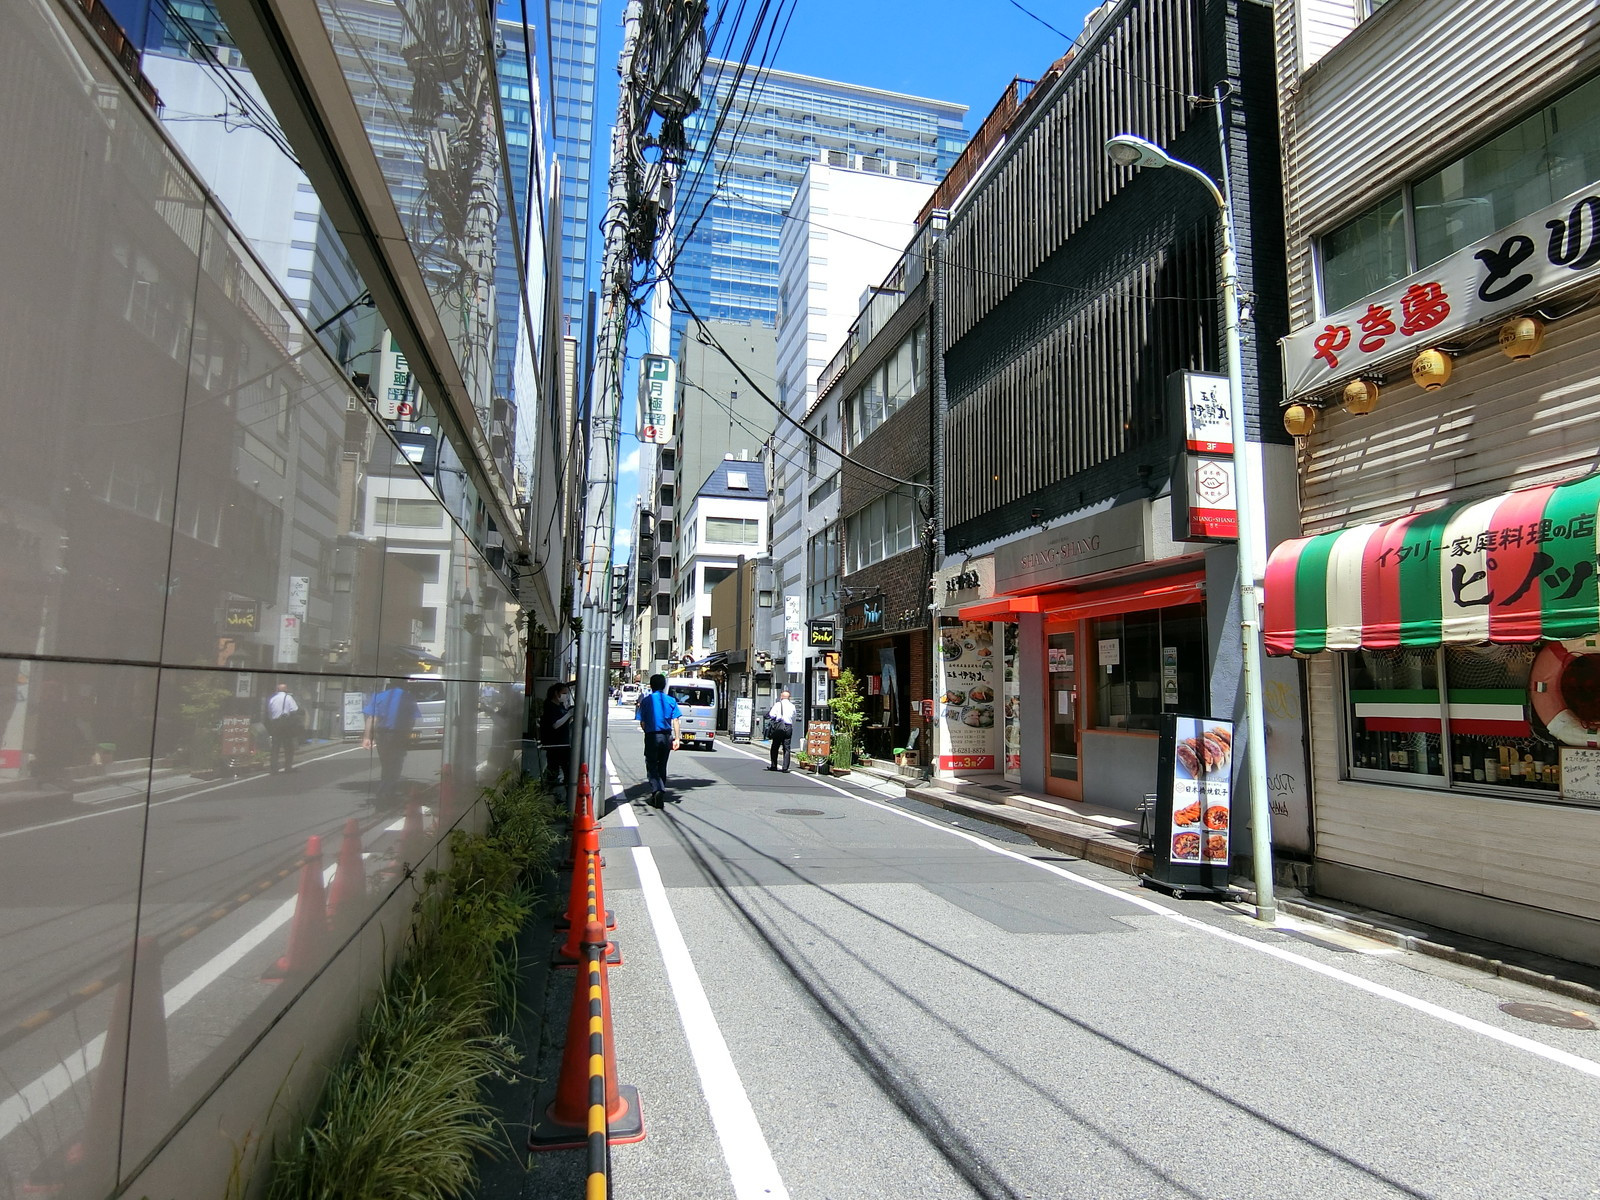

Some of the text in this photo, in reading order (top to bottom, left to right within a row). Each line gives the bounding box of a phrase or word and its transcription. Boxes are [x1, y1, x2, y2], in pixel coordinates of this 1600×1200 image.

[1313, 282, 1452, 369] やき鳥
[650, 360, 666, 378] P
[1375, 513, 1595, 568] イタリー家庭料理の店
[1451, 552, 1600, 608] ピノッ
